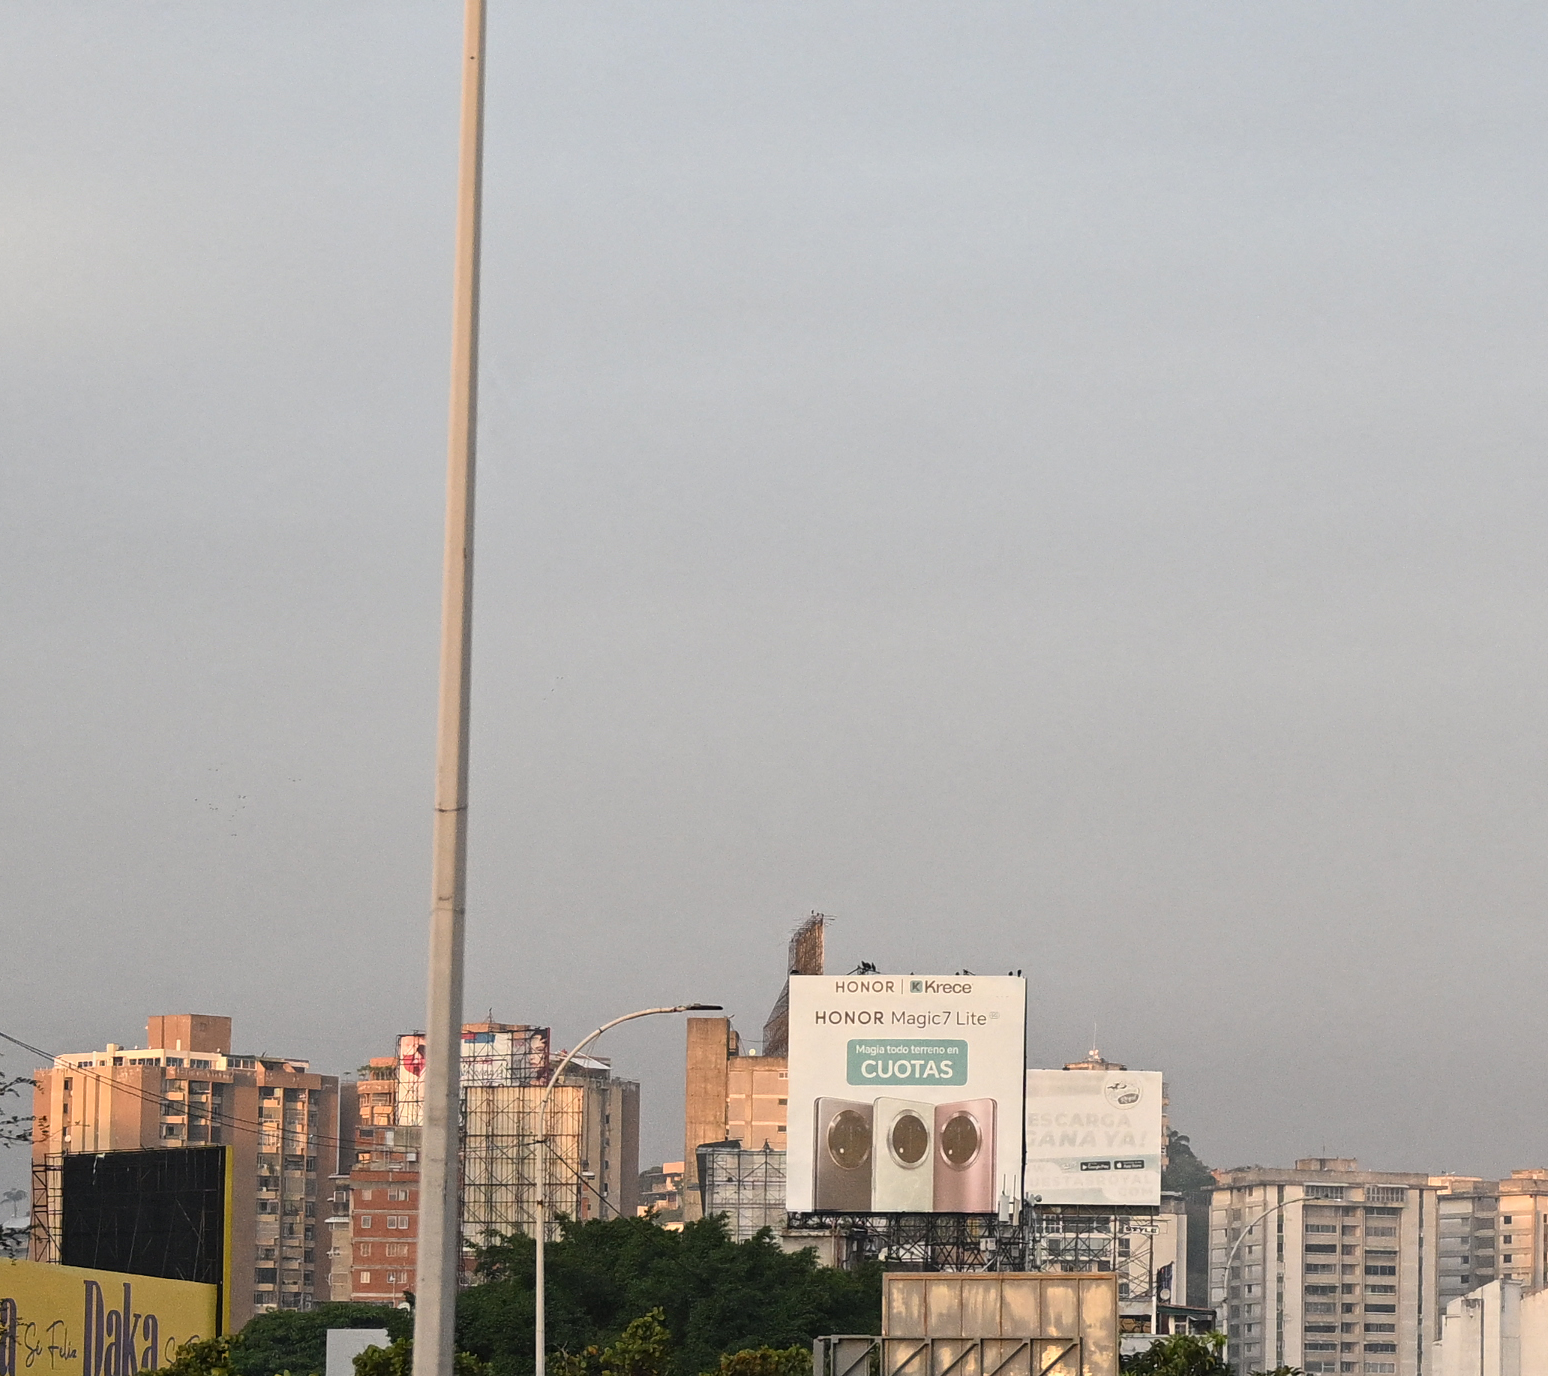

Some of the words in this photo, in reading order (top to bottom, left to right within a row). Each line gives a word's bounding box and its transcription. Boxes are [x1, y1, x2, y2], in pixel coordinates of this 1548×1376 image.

[835, 980, 895, 993] HONOR
[924, 980, 972, 994] Krece
[815, 1011, 884, 1025] HONOR
[891, 1011, 952, 1029] Magic7
[956, 1011, 988, 1026] Lite
[856, 1045, 885, 1056] Magia
[887, 1045, 909, 1055] todo
[911, 1046, 945, 1055] terreno
[861, 1060, 954, 1079] CUOTAS
